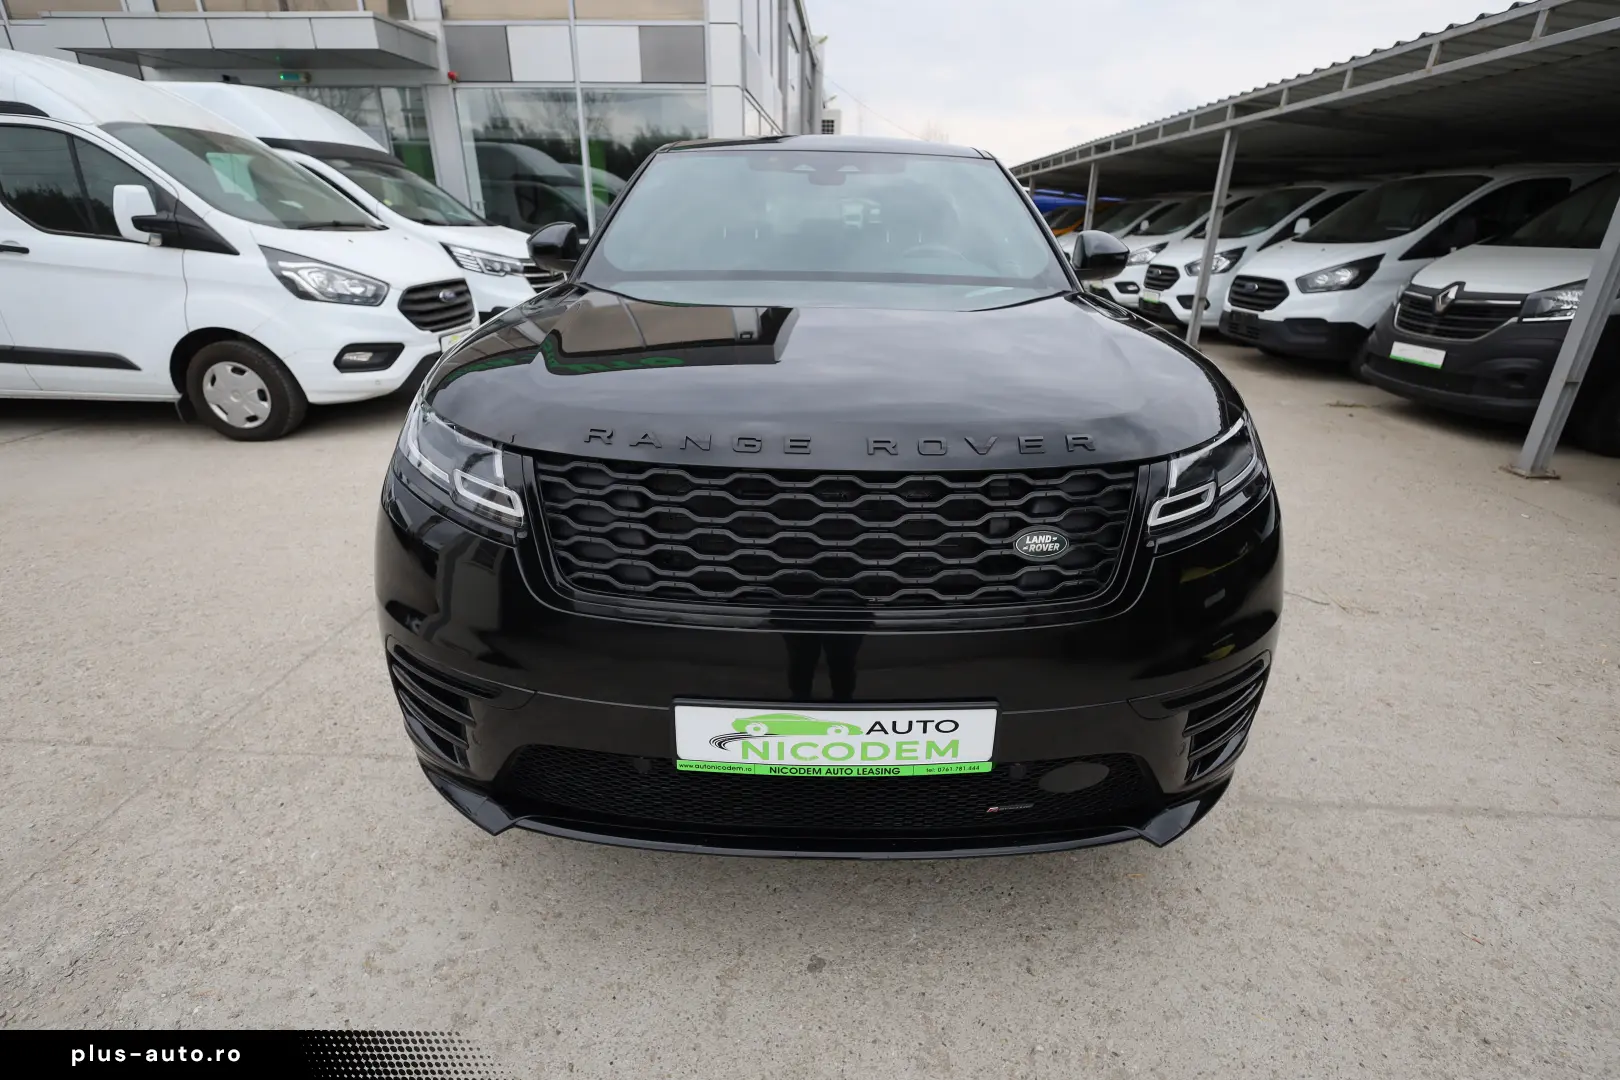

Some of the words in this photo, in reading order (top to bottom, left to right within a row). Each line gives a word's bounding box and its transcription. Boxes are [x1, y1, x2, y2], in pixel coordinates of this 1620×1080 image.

[584, 428, 812, 455] RANGE
[866, 433, 1097, 456] ROVER
[1025, 535, 1052, 544] LAND
[1028, 543, 1060, 552] ROVER
[866, 719, 960, 735] AUTO
[741, 739, 960, 761] NICODEM
[678, 763, 752, 772] www.autonicodem.ro
[769, 766, 822, 775] NICODEM
[825, 767, 853, 776] AUTO
[857, 767, 901, 776] LEASING
[937, 765, 980, 773] 0761.781.444
